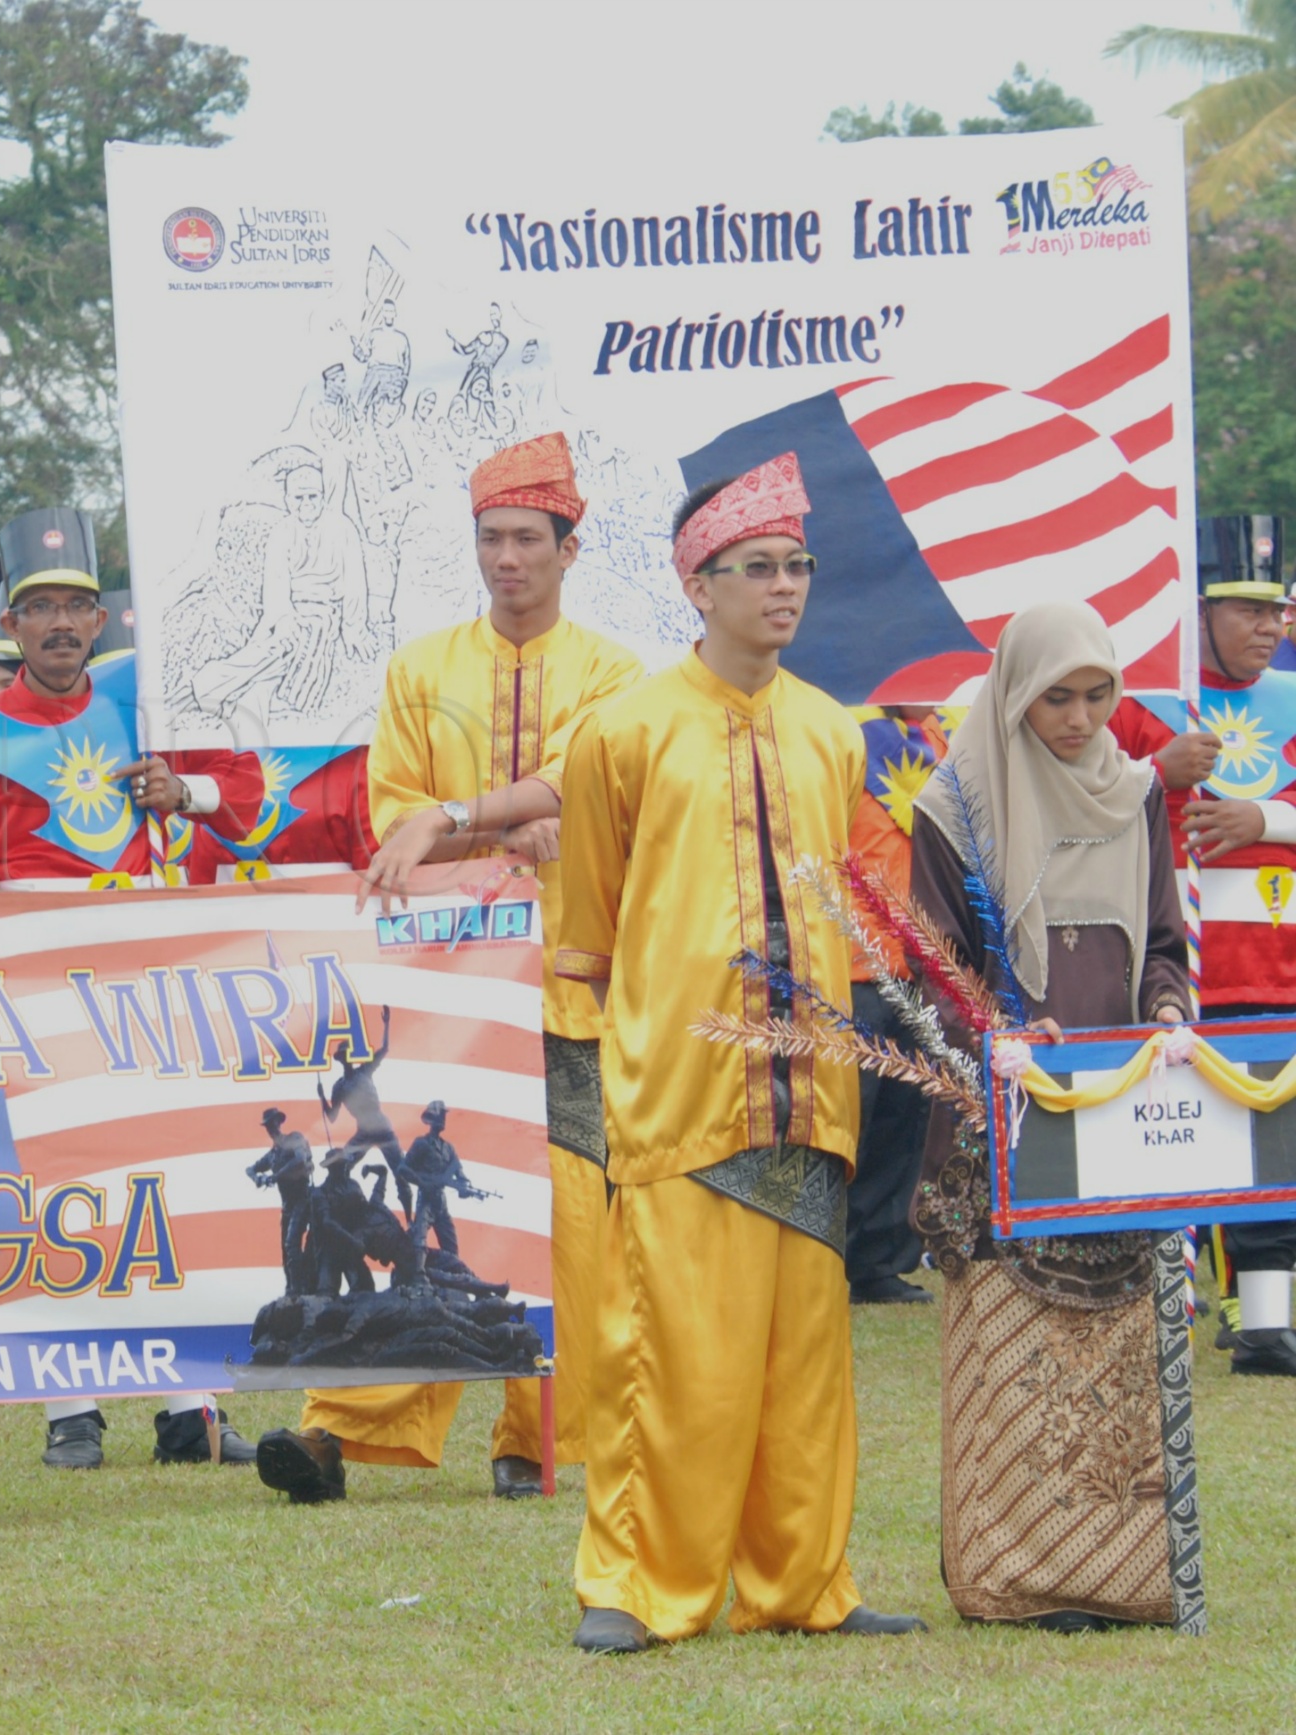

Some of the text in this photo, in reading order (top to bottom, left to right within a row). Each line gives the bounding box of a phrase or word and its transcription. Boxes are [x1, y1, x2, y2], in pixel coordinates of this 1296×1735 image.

[852, 195, 973, 260] Lahir
[1026, 226, 1151, 256] Janji Ditepati
[377, 902, 533, 953] KHAR
[67, 952, 376, 1082] WIRA
[1133, 1100, 1202, 1123] KOLEJ
[1144, 1127, 1195, 1147] KHAR
[29, 1338, 184, 1391] KHAR
